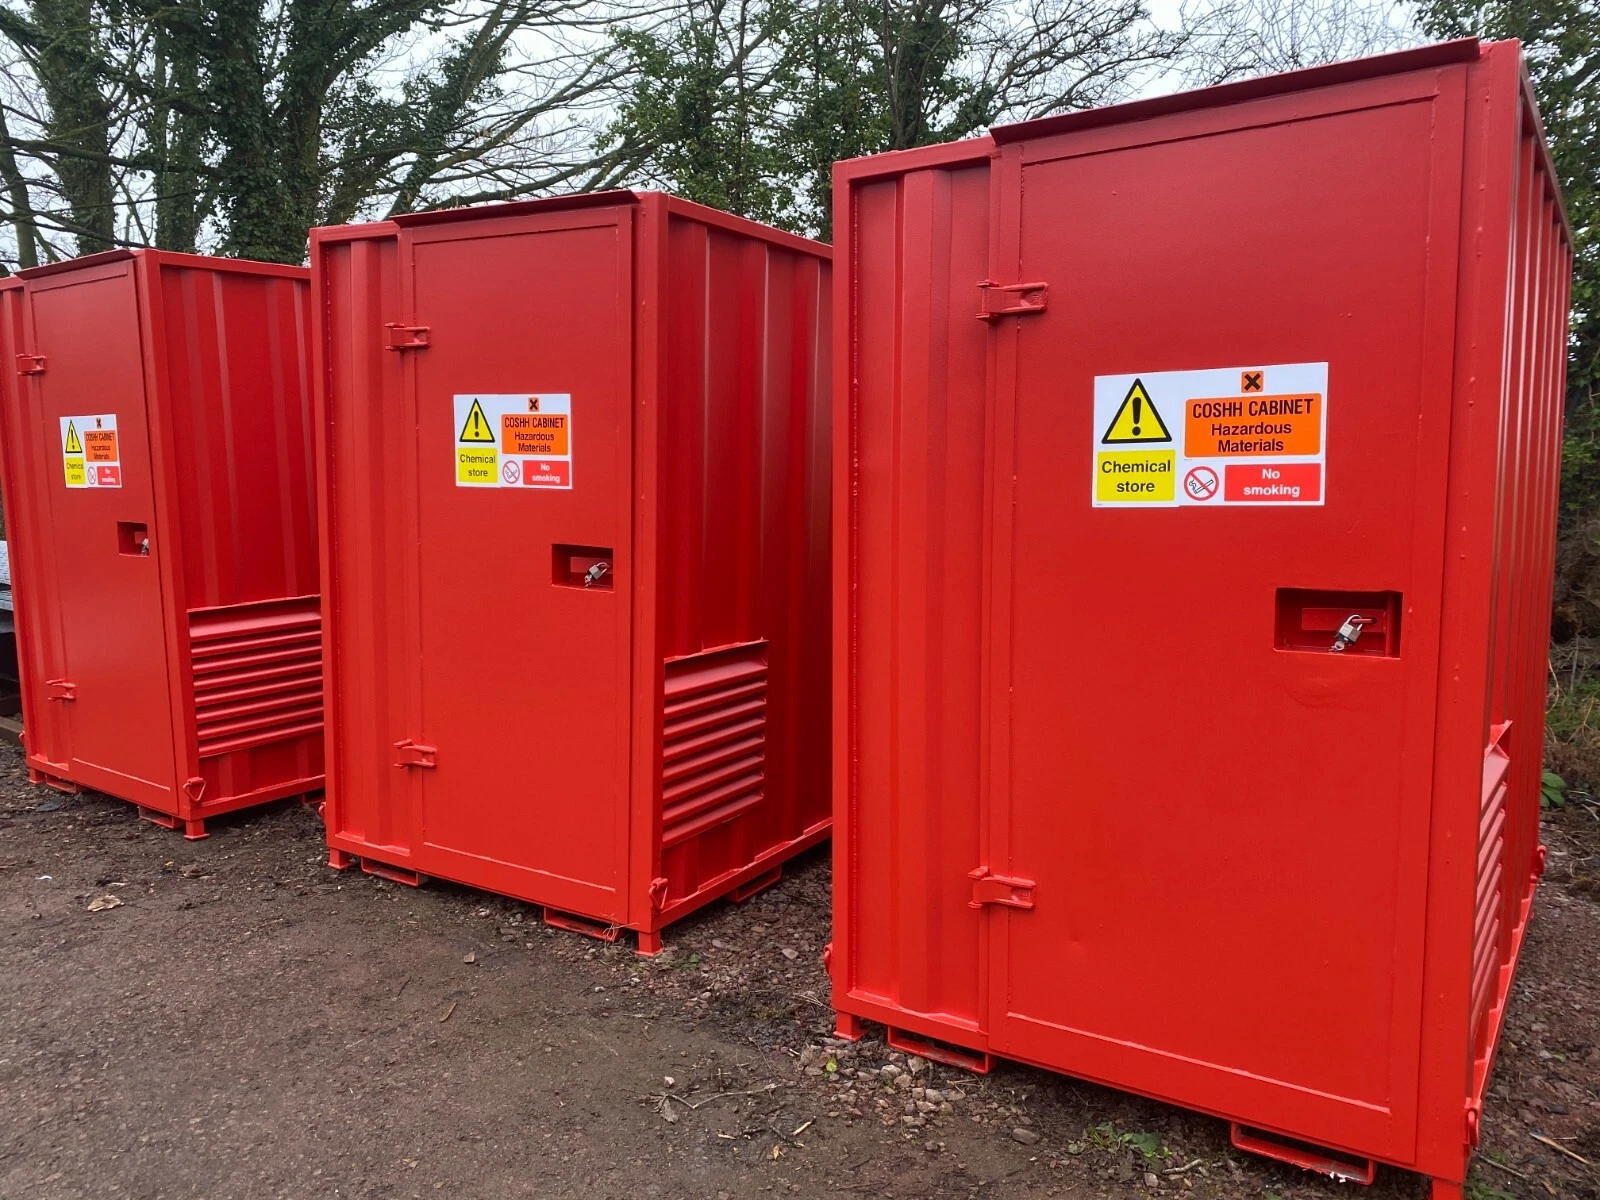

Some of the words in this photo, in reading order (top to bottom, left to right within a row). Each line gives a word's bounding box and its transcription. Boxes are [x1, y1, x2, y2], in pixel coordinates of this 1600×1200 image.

[1192, 402, 1243, 418] COSHH
[1248, 398, 1314, 416] CABINET
[505, 417, 530, 428] COSHH
[532, 417, 564, 428] CABINET
[1211, 422, 1292, 436] Hazardous
[514, 431, 555, 441] Hazardous
[518, 443, 551, 452] Materials
[1217, 438, 1284, 452] Materials
[459, 454, 496, 463] Chemical
[540, 463, 550, 471] No
[1101, 459, 1171, 473] Chemical
[468, 468, 488, 477] store
[1262, 468, 1281, 480] No
[532, 474, 560, 483] smoking
[1116, 480, 1155, 493] store
[1243, 484, 1301, 497] smoking
